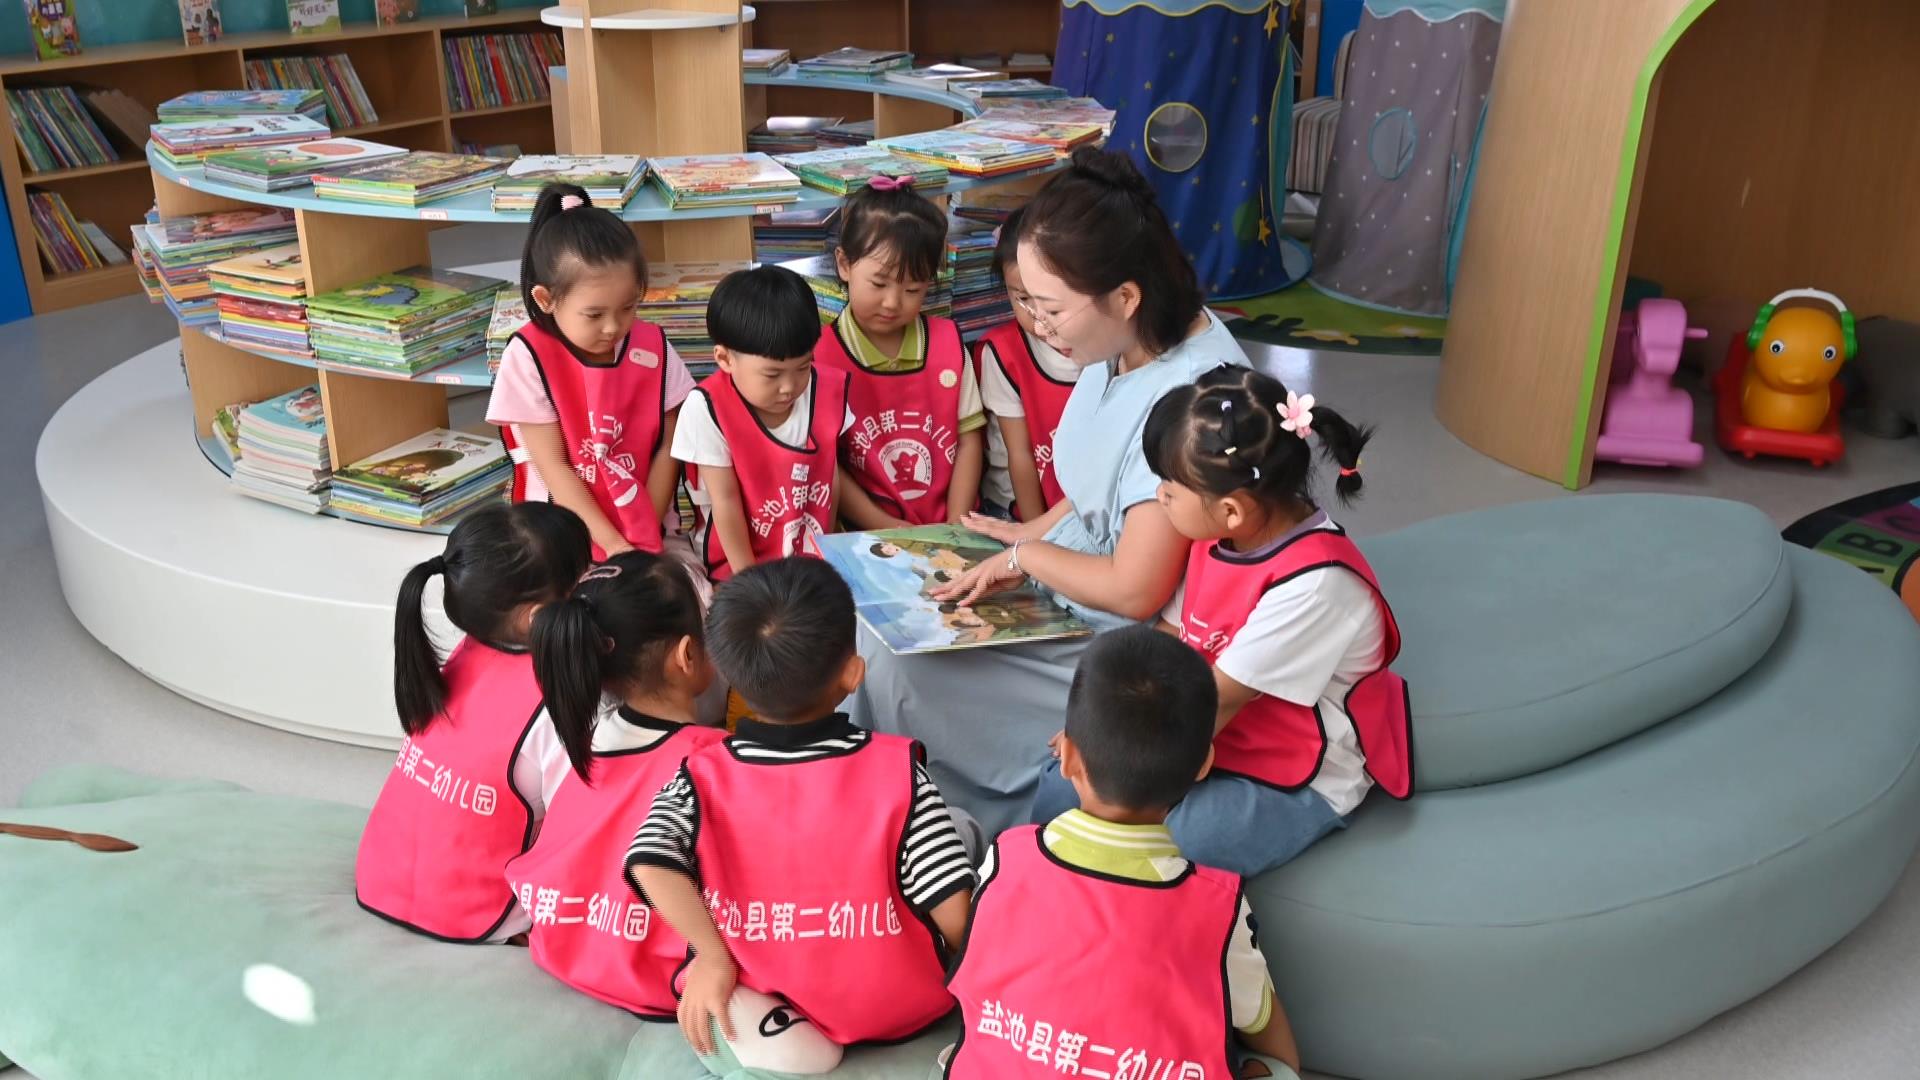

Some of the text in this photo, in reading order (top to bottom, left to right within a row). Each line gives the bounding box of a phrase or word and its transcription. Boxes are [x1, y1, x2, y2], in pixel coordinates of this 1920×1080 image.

[1836, 532, 1904, 557] B
[510, 881, 650, 942] 县第二幼儿园
[977, 999, 1205, 1080] 盐池县第二幼儿园
